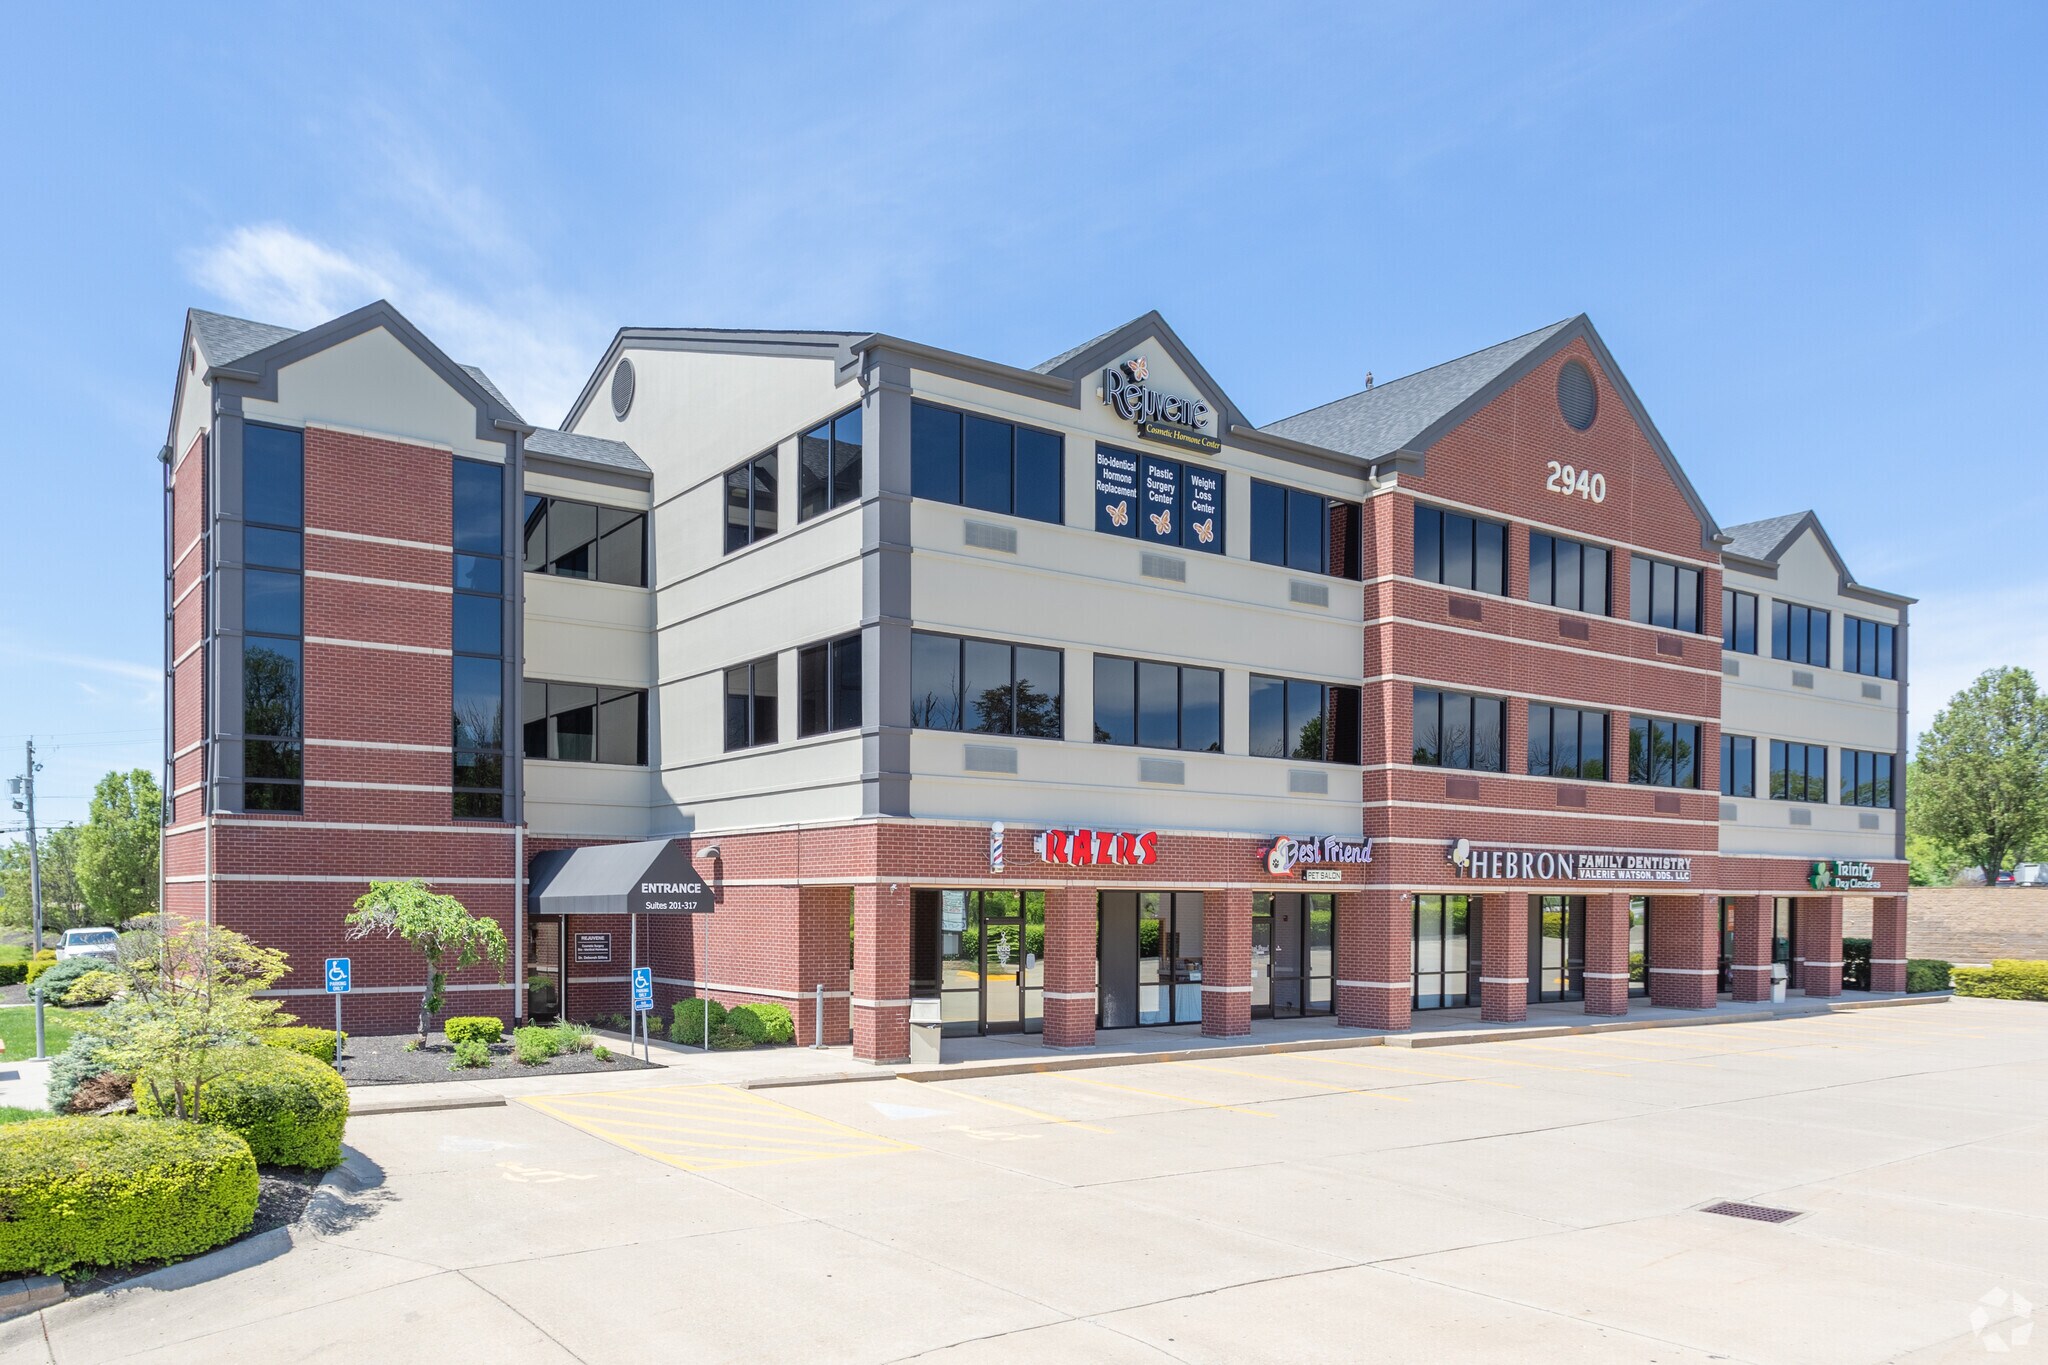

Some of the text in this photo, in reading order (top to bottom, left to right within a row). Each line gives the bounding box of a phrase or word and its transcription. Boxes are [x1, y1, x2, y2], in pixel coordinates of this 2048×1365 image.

[1146, 423, 1220, 450] Cosmetic Hormone Center
[1097, 453, 1137, 472] Bio-identical
[1103, 468, 1132, 484] Hormone
[1148, 465, 1174, 480] Plastic
[1096, 479, 1137, 498] Replacement
[1146, 477, 1175, 495] Surgery
[1190, 474, 1216, 491] Weight
[1546, 460, 1606, 504] 2940
[1148, 490, 1174, 505] Center
[1194, 488, 1212, 502] Loss
[1191, 500, 1216, 514] Center
[1042, 828, 1158, 867] RAZRS
[1280, 835, 1372, 870] Best Friend
[1578, 854, 1624, 869] FAMILY
[1627, 856, 1692, 870] DENTISTRY
[1307, 871, 1341, 880] PET SALON
[1580, 869, 1616, 879] VALERIE
[1617, 870, 1654, 880] WATSON,
[1675, 872, 1690, 880] LLC
[641, 883, 701, 893] ENTRANCE
[645, 901, 698, 910] Suites 201-317
